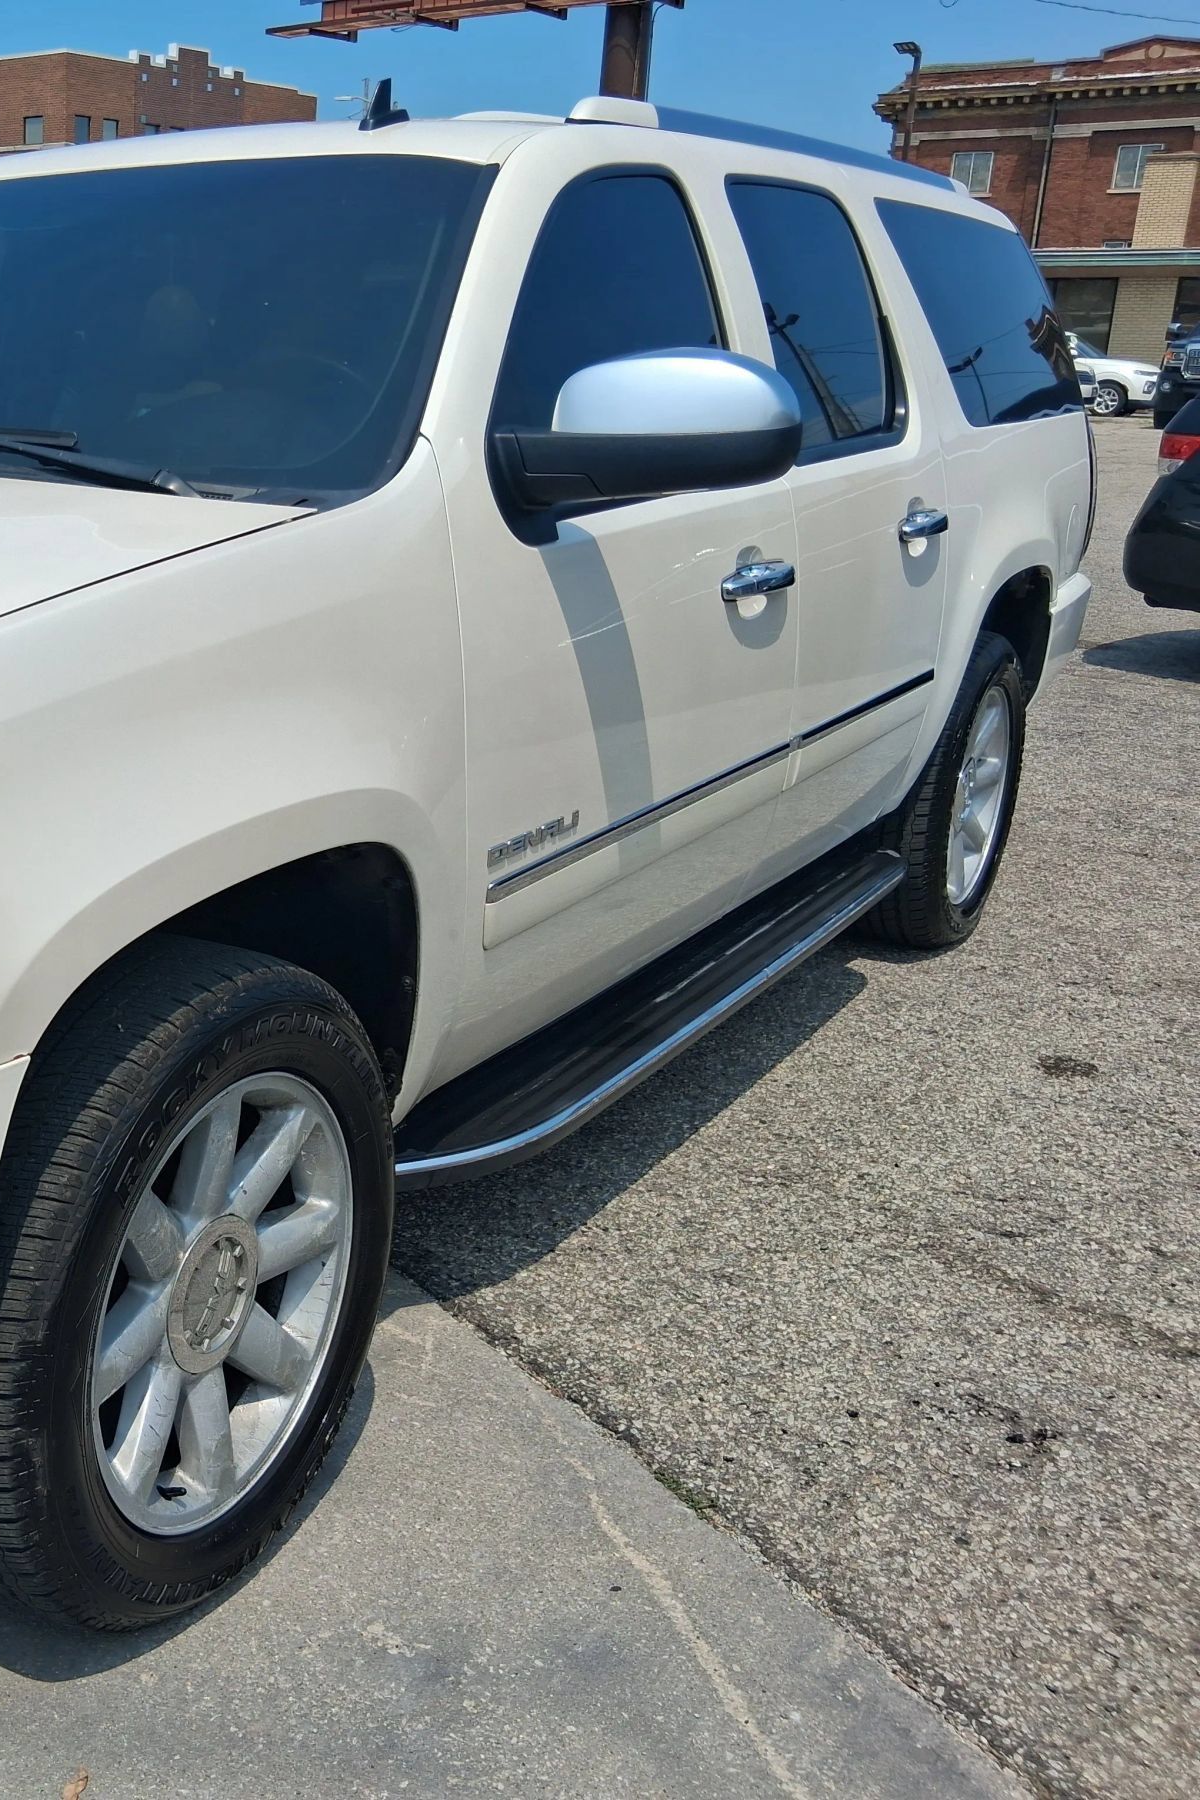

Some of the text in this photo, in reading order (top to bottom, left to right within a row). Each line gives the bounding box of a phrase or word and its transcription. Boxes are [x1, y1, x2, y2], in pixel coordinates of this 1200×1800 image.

[486, 810, 580, 868] DENALI
[111, 1011, 382, 1208] ROCKY MOUNTAIN
